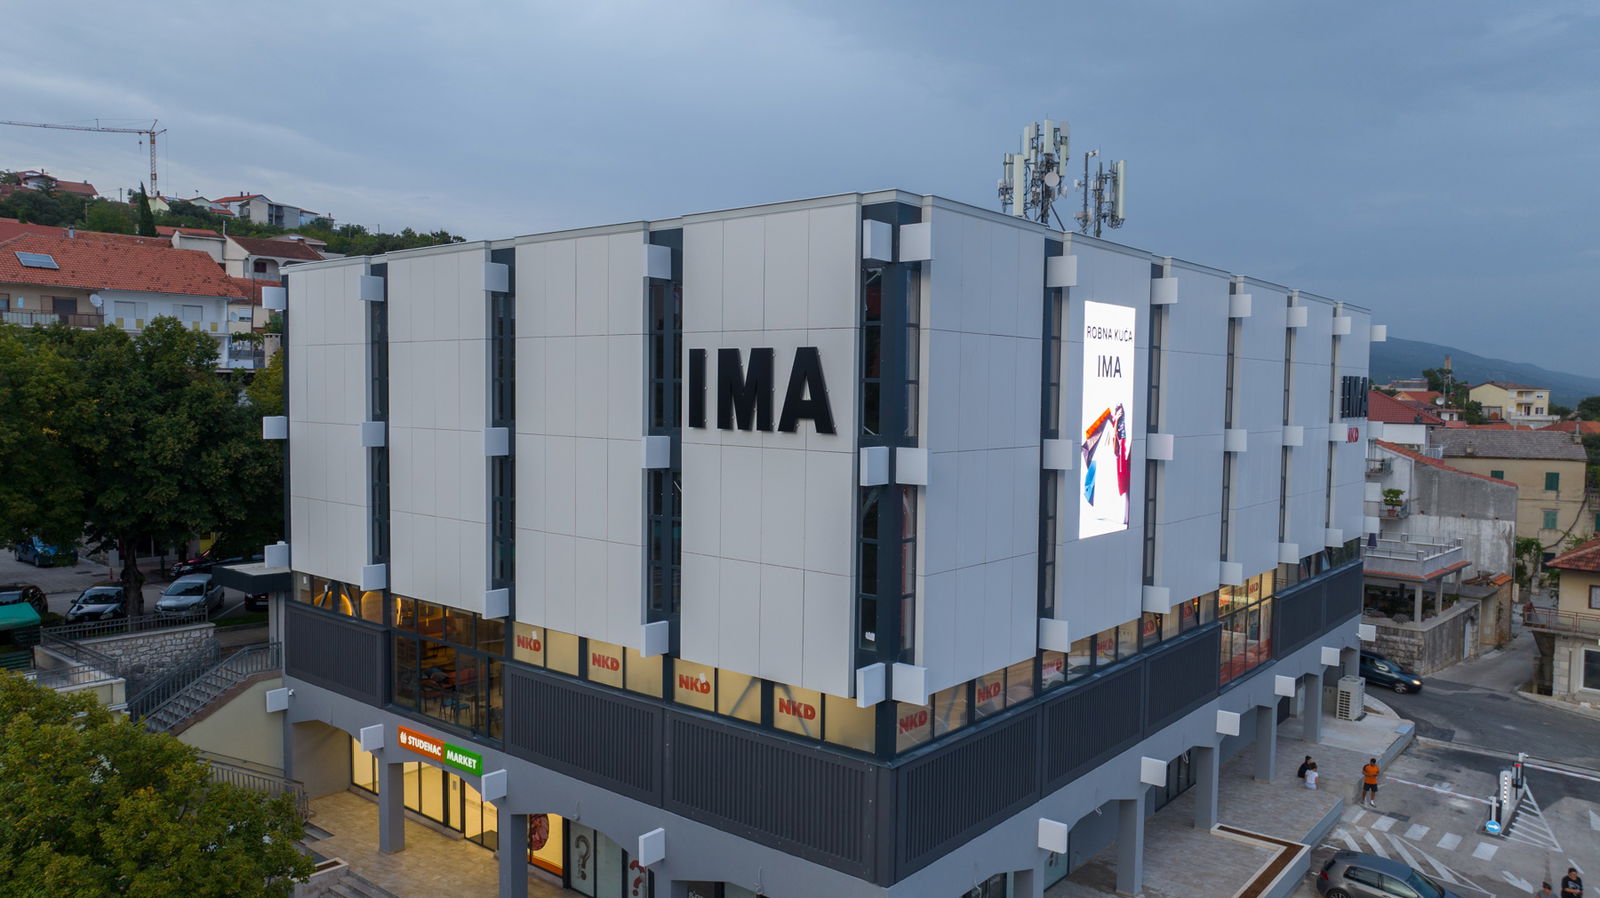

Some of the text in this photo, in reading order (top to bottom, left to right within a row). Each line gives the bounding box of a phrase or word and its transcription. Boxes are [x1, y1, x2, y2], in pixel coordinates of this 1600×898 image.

[1087, 326, 1112, 340] ROBNA
[1097, 355, 1122, 378] IMA
[688, 347, 836, 434] IMA
[516, 634, 541, 652] NKD
[592, 652, 620, 672] NKD
[678, 673, 711, 695] NKD
[978, 681, 1001, 704] NKD
[778, 697, 816, 721] NKD
[899, 710, 928, 735] NKD
[408, 735, 477, 770] STUDENAC MARKET
